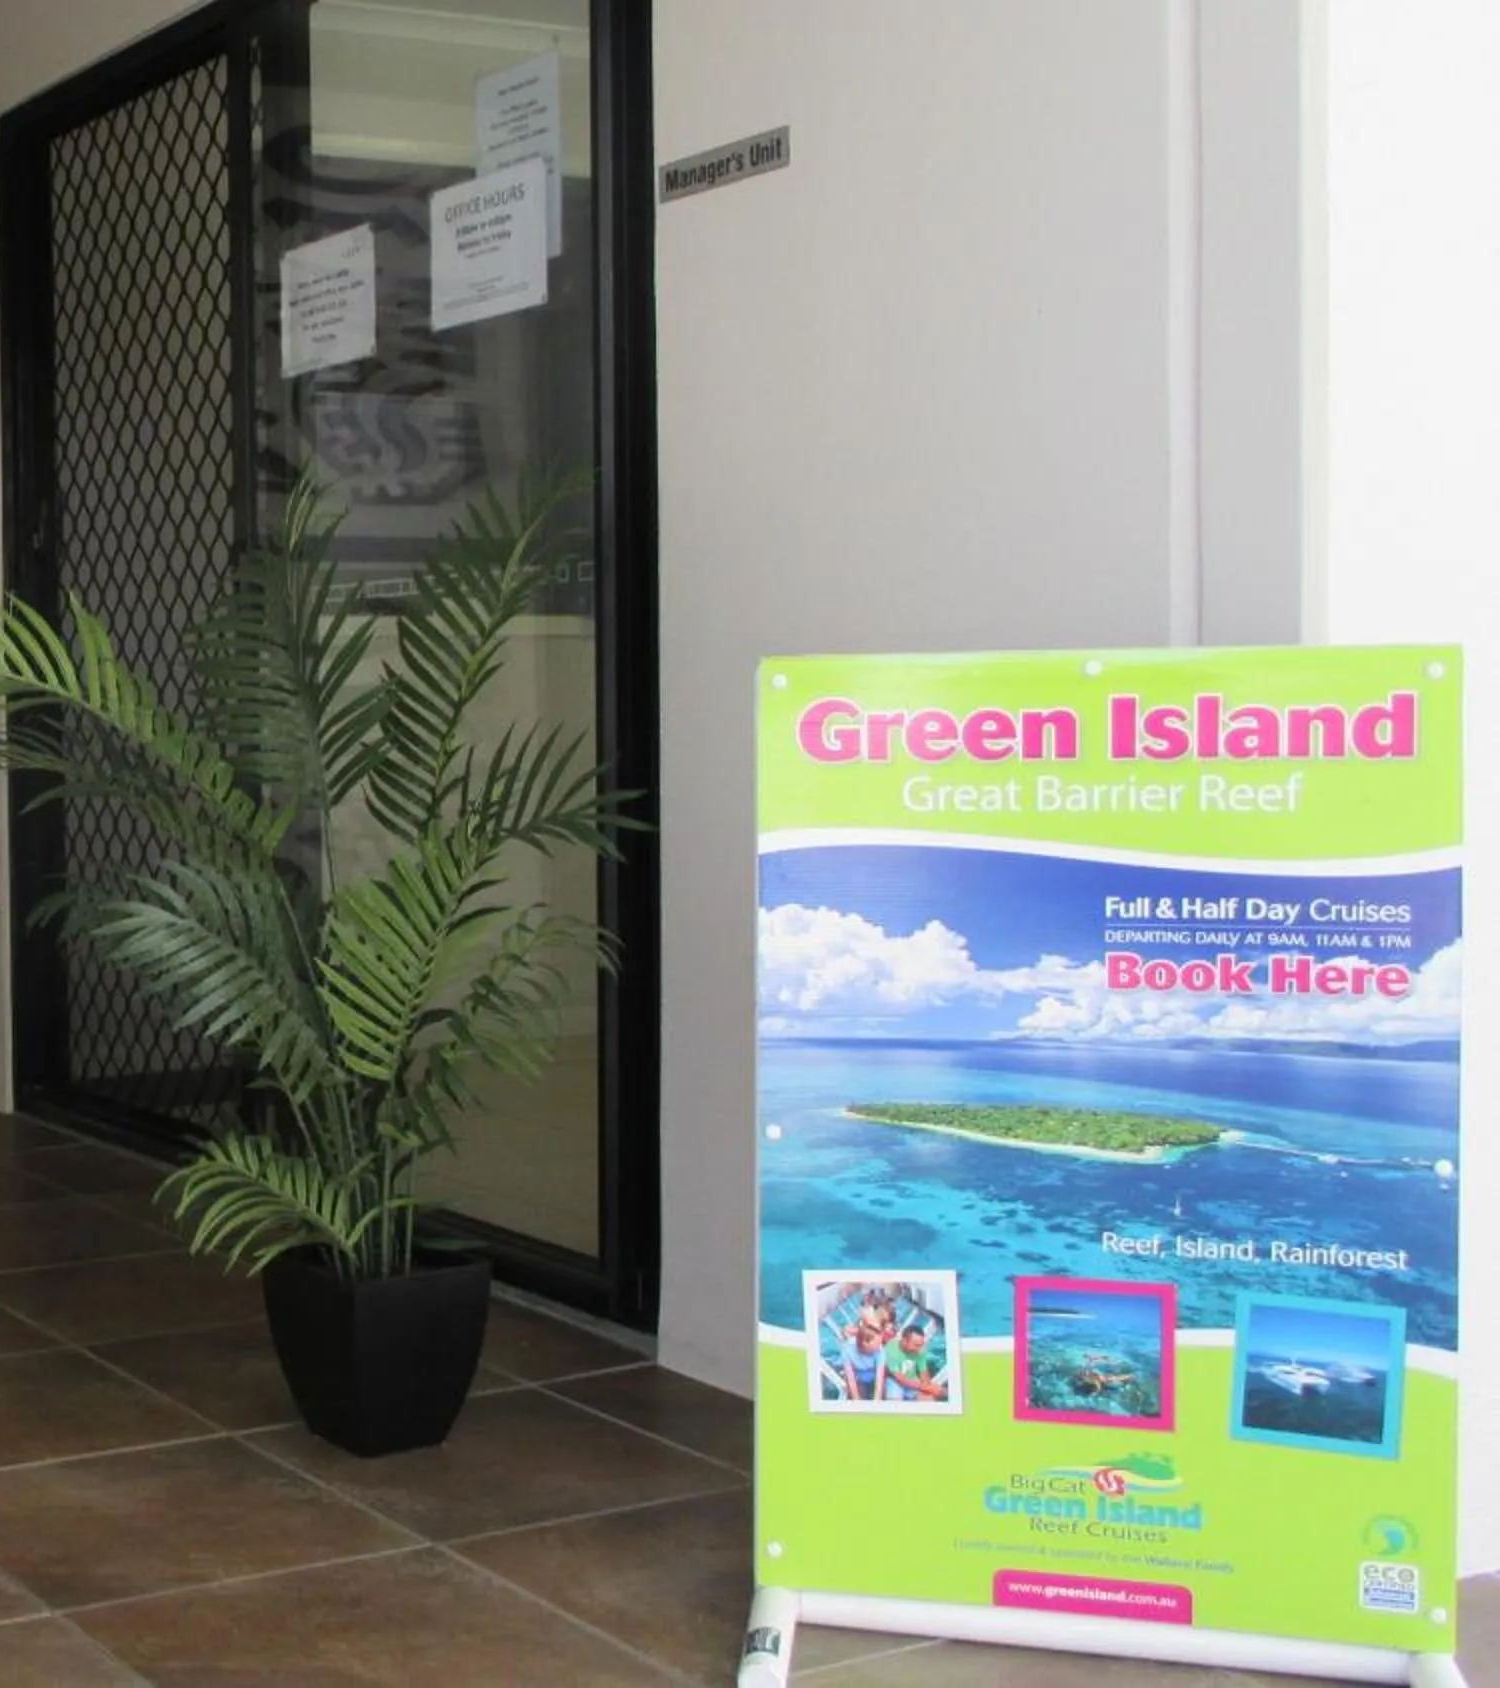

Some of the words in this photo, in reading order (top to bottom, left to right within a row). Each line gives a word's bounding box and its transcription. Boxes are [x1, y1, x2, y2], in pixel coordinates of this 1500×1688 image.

[665, 152, 744, 193] Manager's
[749, 137, 782, 168] Unit
[444, 196, 482, 224] OFFICE
[483, 182, 525, 211] HOURS
[795, 697, 1080, 764] Green
[1108, 690, 1419, 761] Island
[902, 775, 1023, 813] Great
[1036, 775, 1186, 813] Barrier
[1199, 772, 1305, 812] Reef
[1105, 896, 1150, 919] Full
[1155, 898, 1177, 919] &
[1181, 897, 1239, 920] Half
[1246, 899, 1301, 925] Day
[1310, 899, 1412, 924] Cruises
[1105, 930, 1191, 945] DEPARTING
[1196, 931, 1242, 946] DAILY
[1245, 932, 1264, 945] AT
[1316, 933, 1357, 947] 11AM
[1360, 934, 1372, 947] &
[1379, 934, 1412, 948] 1PM
[1105, 951, 1254, 994] Book
[1268, 954, 1412, 997] Here
[1101, 1231, 1167, 1259] Reef,
[1270, 1241, 1409, 1271] Rainforest
[984, 1485, 1088, 1519] Green
[1097, 1496, 1203, 1531] Island
[1029, 1516, 1079, 1535] Reef
[1086, 1522, 1169, 1545] Cruises
[1363, 1564, 1415, 1583] eco
[1007, 1580, 1178, 1609] www.greenisland.com.au
